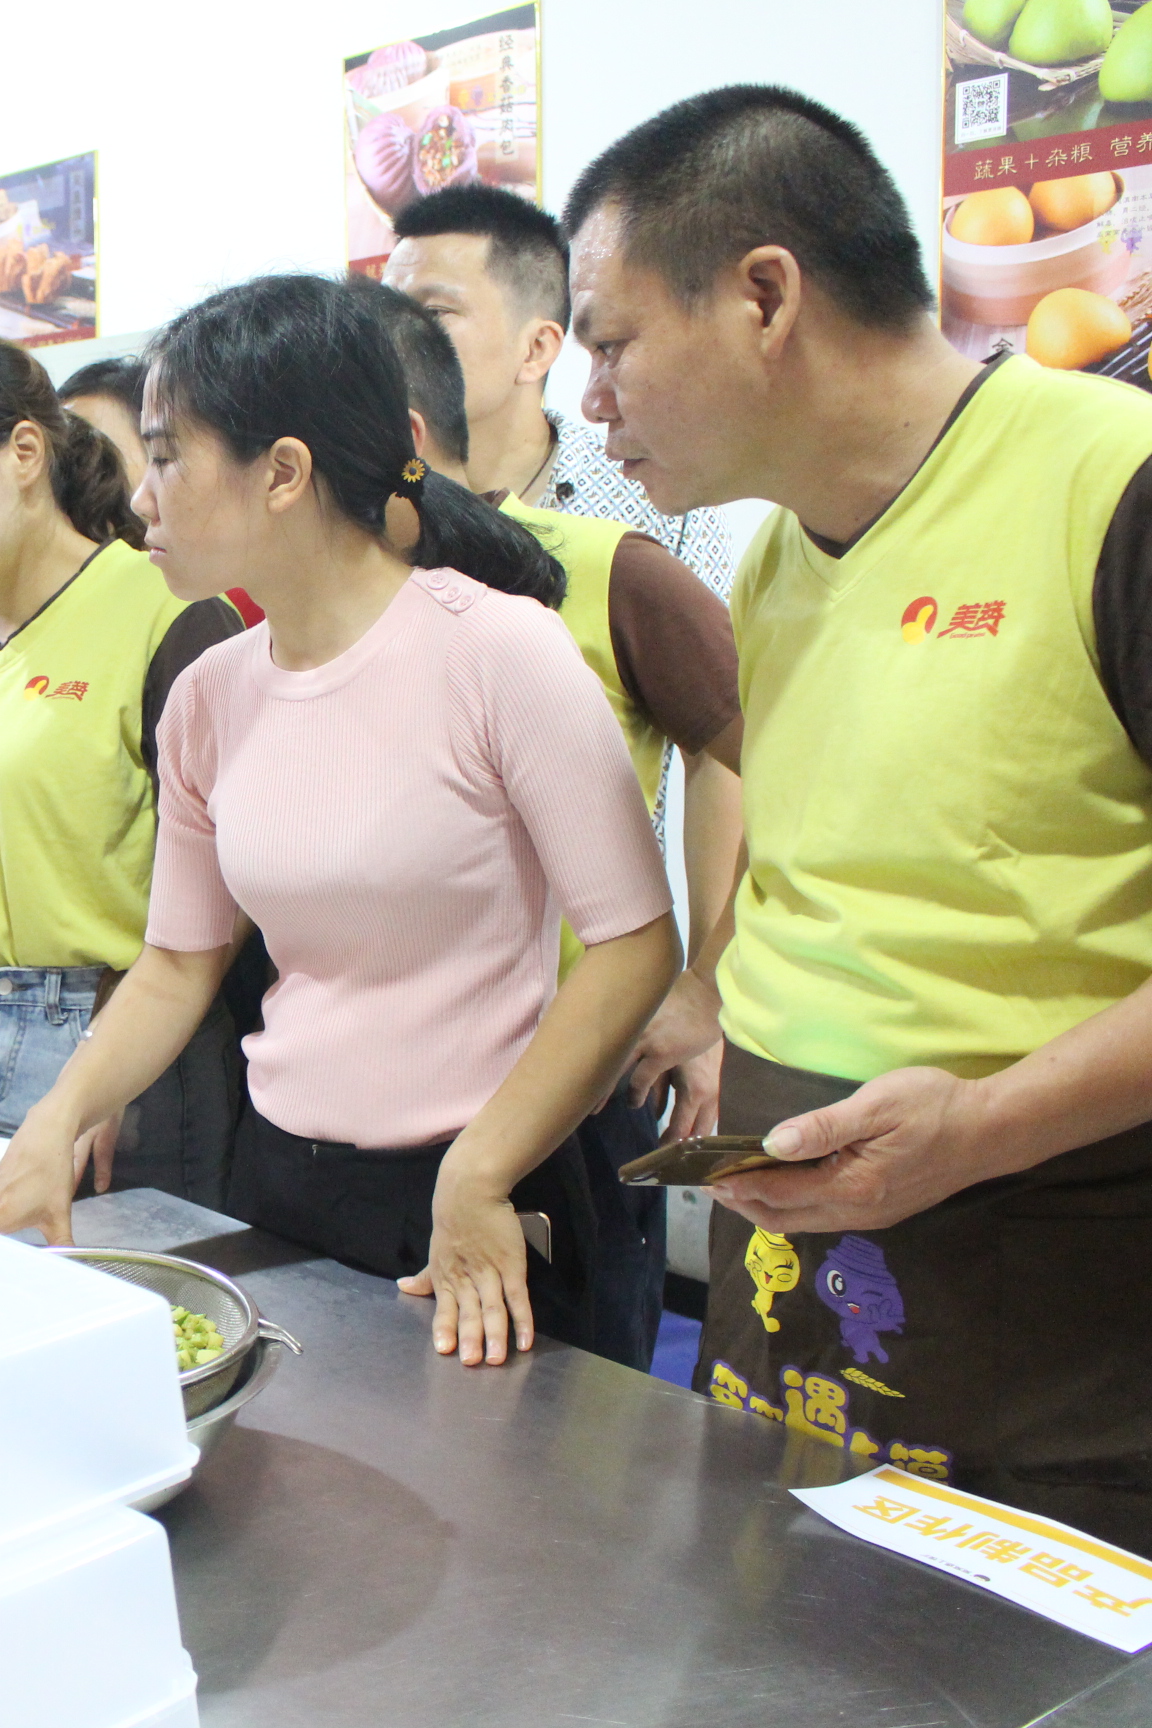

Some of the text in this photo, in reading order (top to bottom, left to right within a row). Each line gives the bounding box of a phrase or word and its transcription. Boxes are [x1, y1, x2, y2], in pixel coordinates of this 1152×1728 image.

[1110, 132, 1152, 157] 营养
[851, 1494, 1152, 1618] 产品制作区
